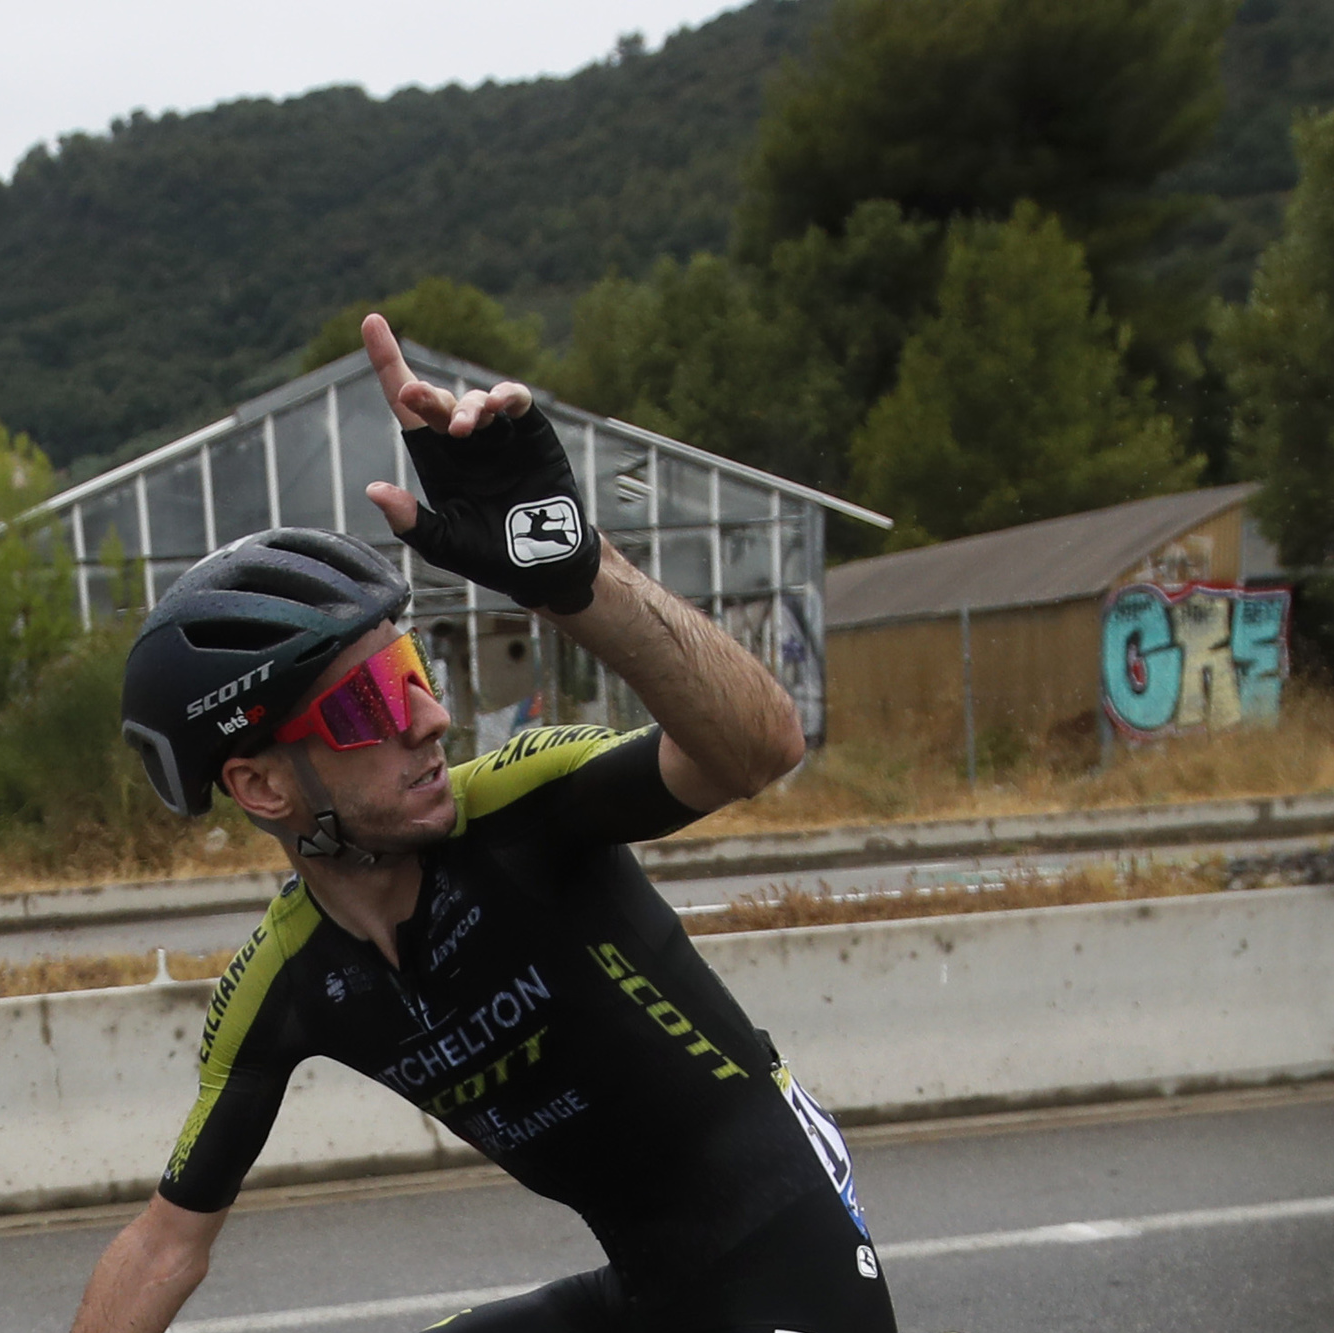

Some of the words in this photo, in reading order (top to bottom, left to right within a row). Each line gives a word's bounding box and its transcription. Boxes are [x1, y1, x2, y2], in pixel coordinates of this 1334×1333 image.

[185, 659, 275, 721] SCOTT
[428, 904, 483, 973] Jayco
[373, 964, 555, 1095] ITCHELTON
[586, 942, 750, 1080] SCOTT
